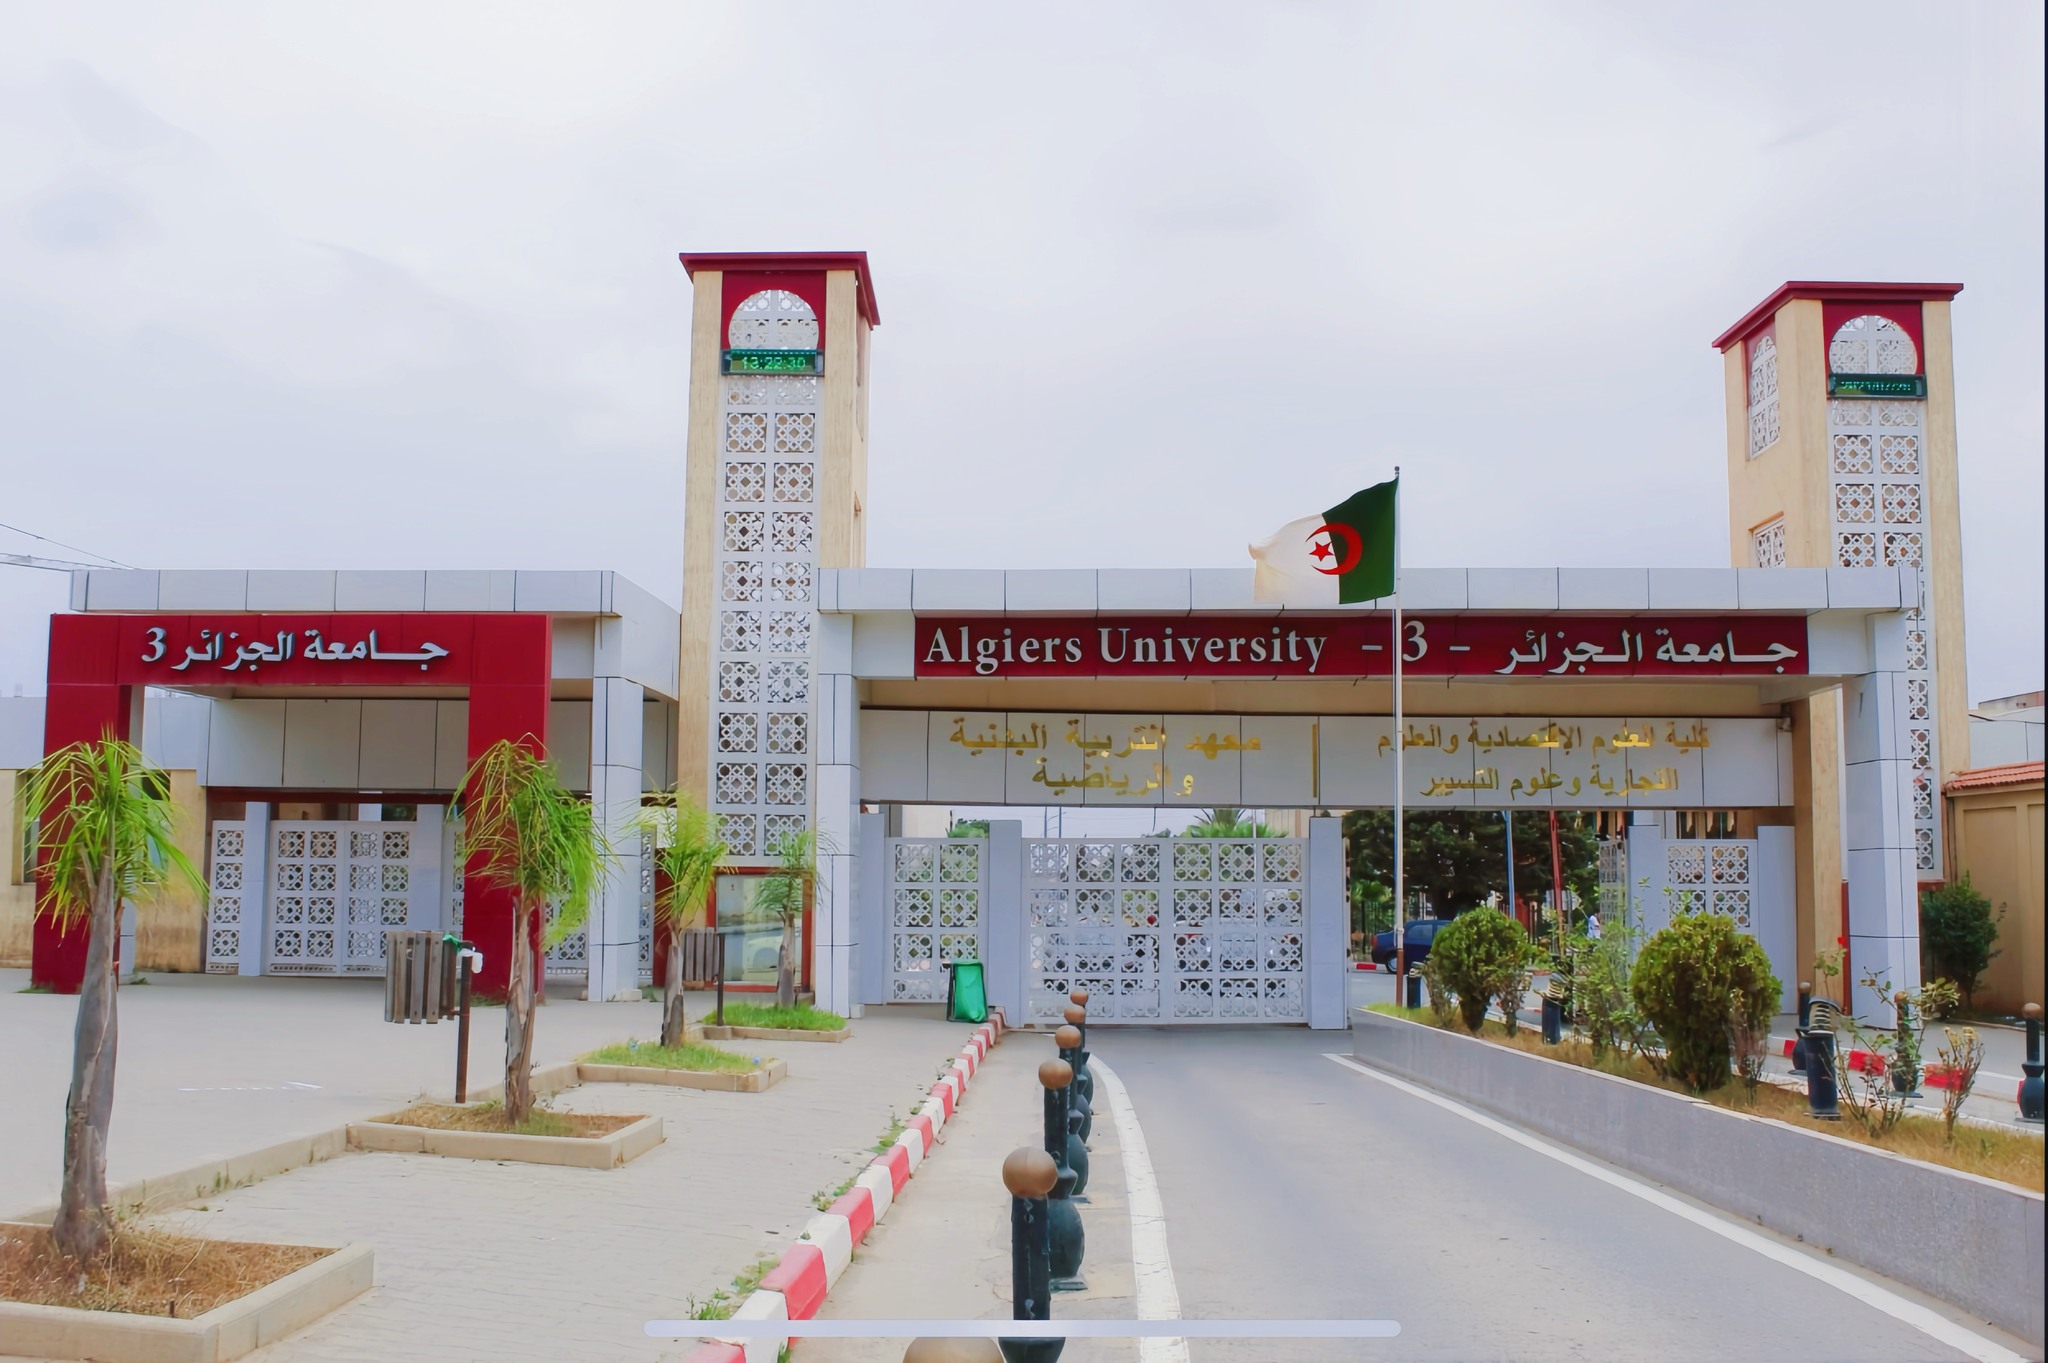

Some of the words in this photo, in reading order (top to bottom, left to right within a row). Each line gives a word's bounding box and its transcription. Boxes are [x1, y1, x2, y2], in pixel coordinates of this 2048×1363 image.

[141, 626, 167, 662] 3
[170, 629, 296, 672] الجزائر
[303, 629, 450, 671] جامعة
[923, 626, 1083, 675] Algiers
[1098, 626, 1328, 674] University
[1402, 620, 1428, 662] 3
[1494, 628, 1643, 675] الجزائر
[1656, 628, 1799, 674] جامعة
